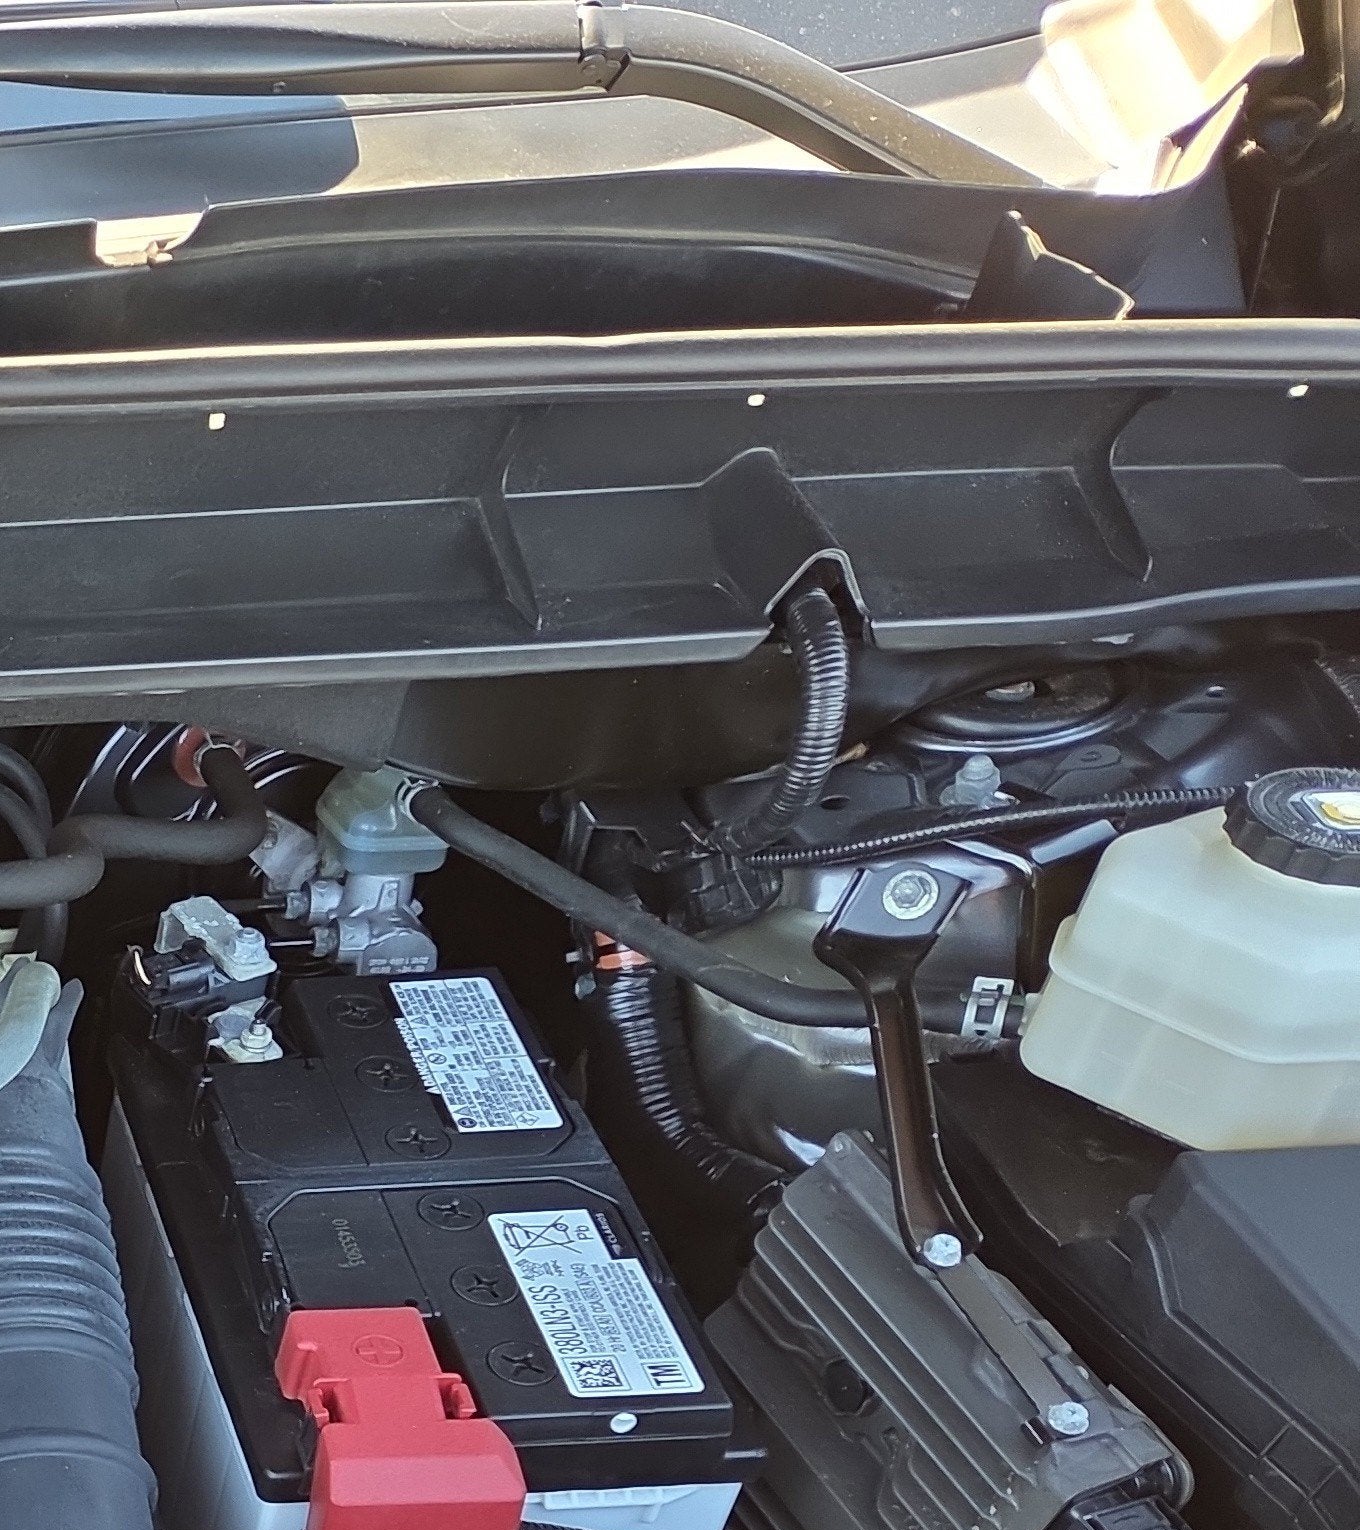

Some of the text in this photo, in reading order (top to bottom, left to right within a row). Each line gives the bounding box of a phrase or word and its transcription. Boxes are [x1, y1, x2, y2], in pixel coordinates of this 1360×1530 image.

[575, 1225, 595, 1241] Pb
[528, 1284, 587, 1354] 380LN3-ISS
[646, 1364, 688, 1386] TM
